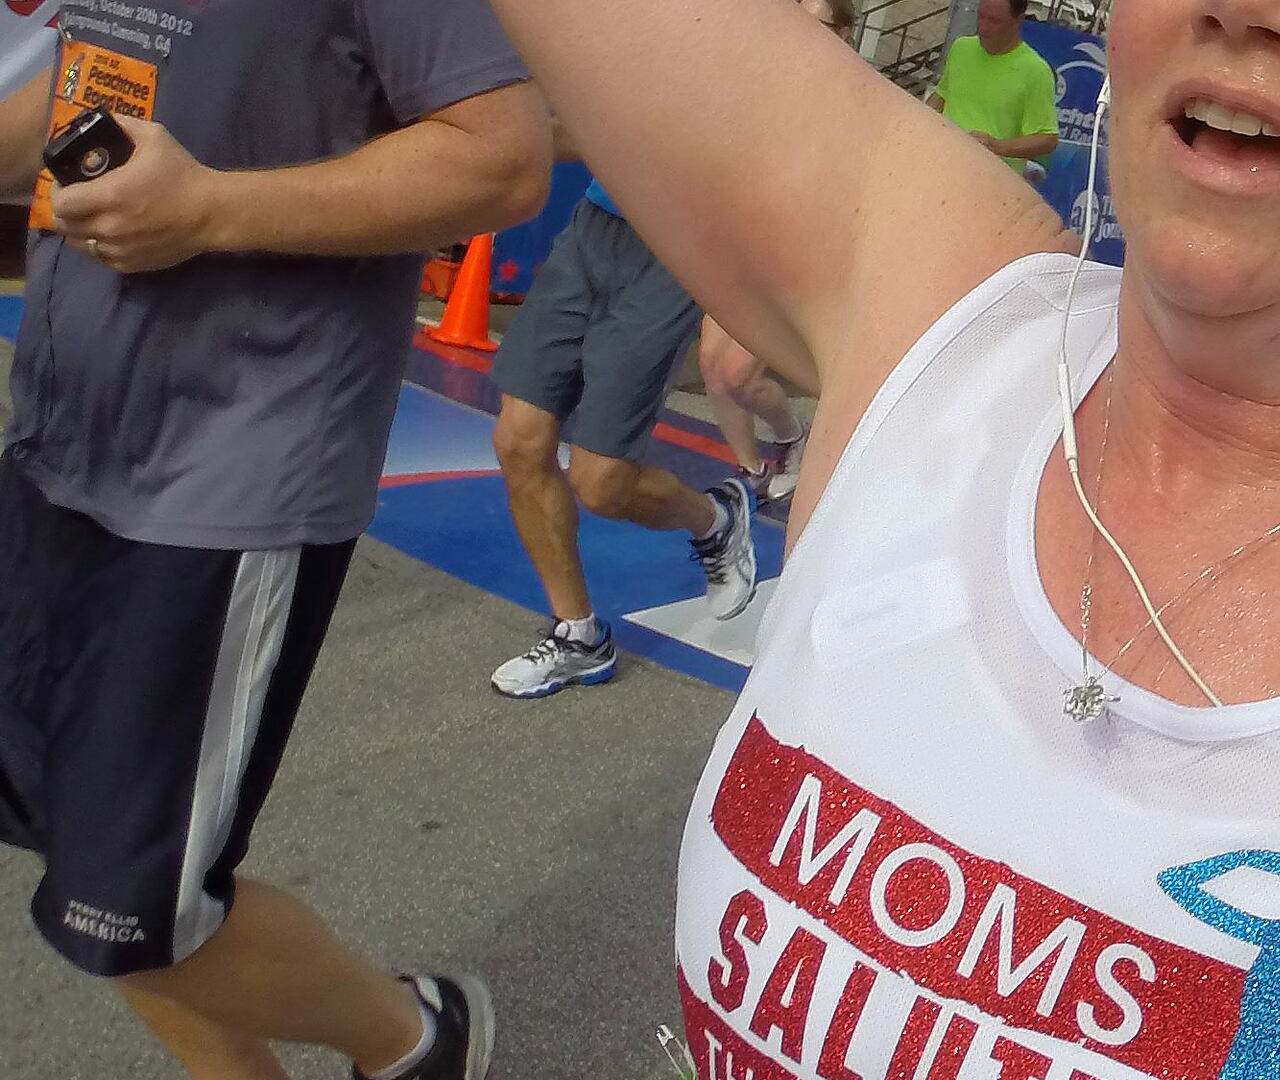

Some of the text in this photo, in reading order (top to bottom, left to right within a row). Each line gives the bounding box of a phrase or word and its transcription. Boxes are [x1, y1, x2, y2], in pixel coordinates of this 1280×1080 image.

[160, 12, 193, 36] 2012
[88, 66, 149, 102] Peachtree
[769, 772, 1156, 1046] MOMS
[706, 889, 1162, 1080] SALUT
